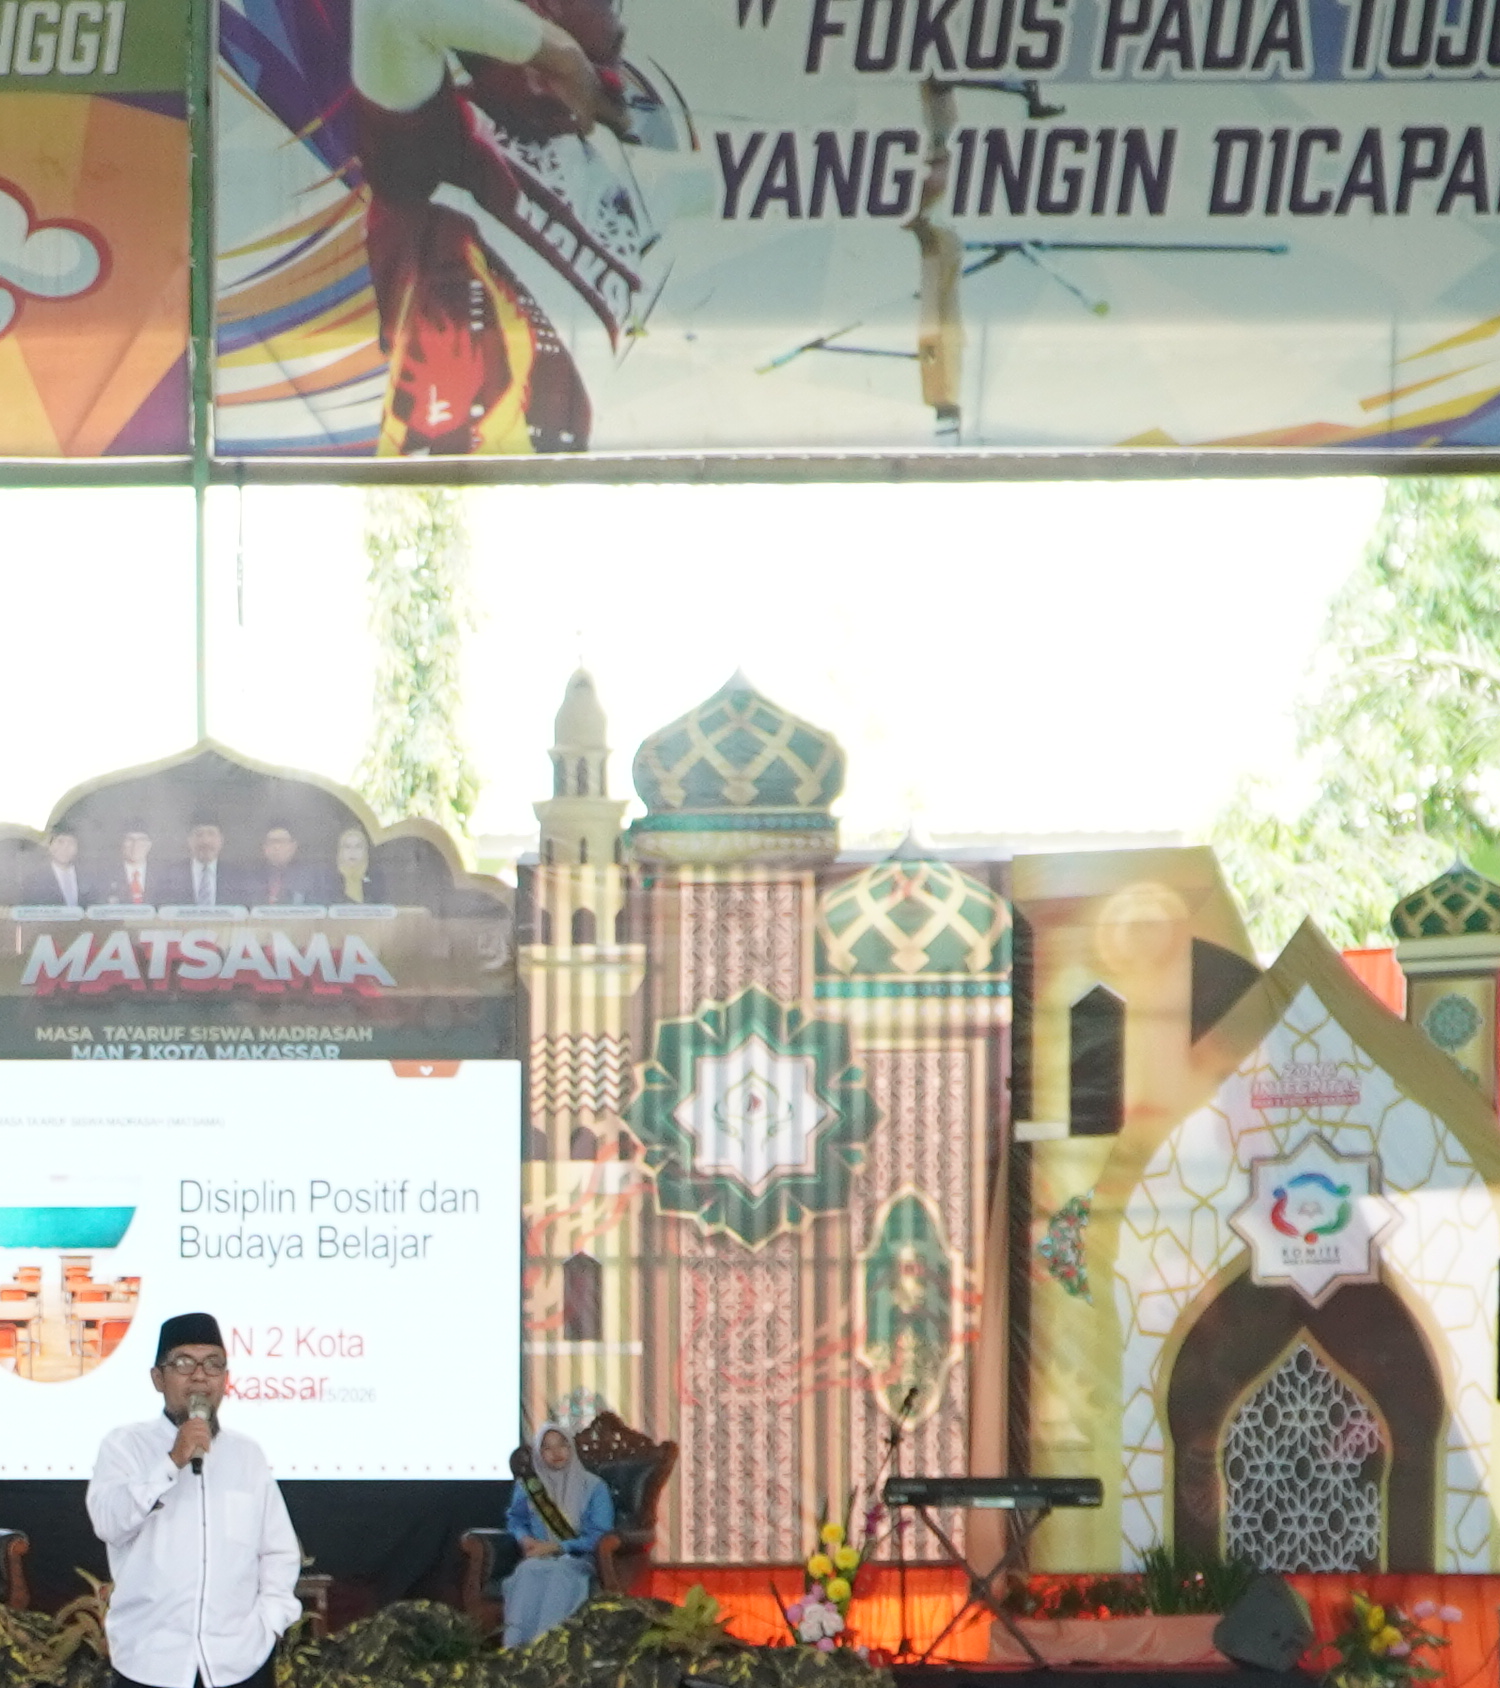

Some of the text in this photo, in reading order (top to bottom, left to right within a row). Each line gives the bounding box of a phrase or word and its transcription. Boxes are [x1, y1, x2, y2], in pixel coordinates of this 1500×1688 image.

[715, 131, 920, 218] YANG
[953, 128, 1179, 216] INGIN
[20, 929, 398, 988] MATSAMA
[36, 1024, 374, 1042] MASA TA'ARUF SISWA MADRASAH
[71, 1043, 340, 1060] MAN 2 KOTA MAKASSAR
[180, 1179, 479, 1221] Disiplin Positif dan
[180, 1226, 433, 1268] Budaya Belajar
[266, 1327, 284, 1357] 2
[296, 1327, 365, 1358] Kota
[224, 1371, 329, 1400] kassar
